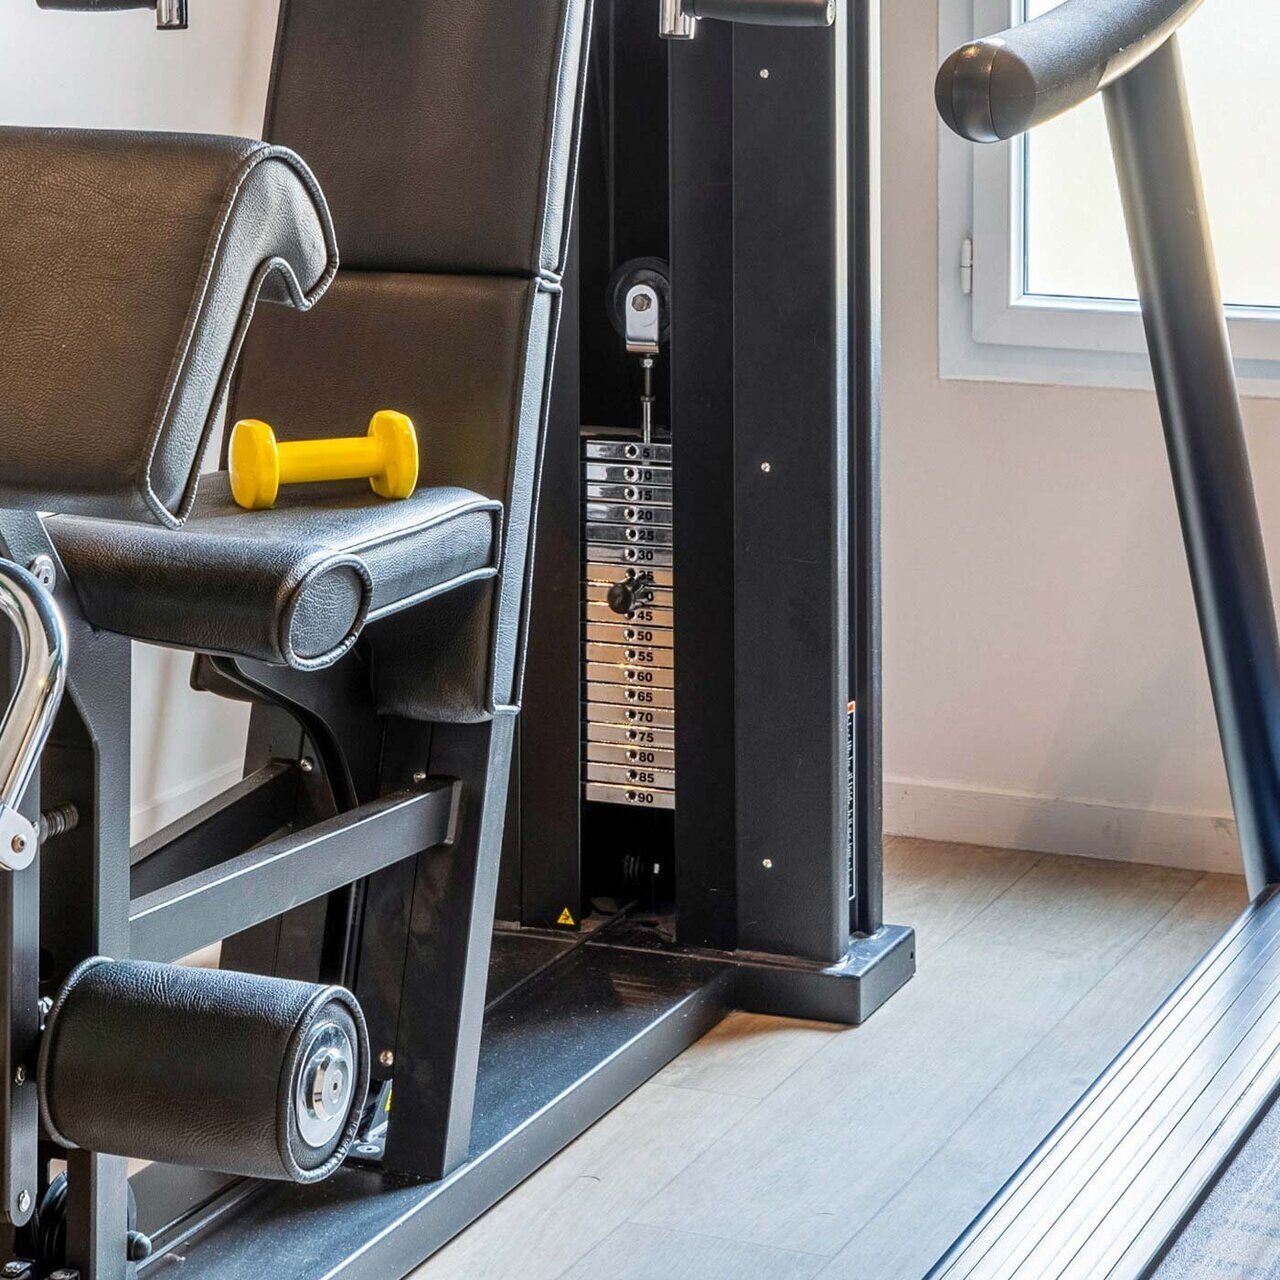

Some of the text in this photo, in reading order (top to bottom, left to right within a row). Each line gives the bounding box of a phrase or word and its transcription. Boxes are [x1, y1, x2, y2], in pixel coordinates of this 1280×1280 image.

[642, 447, 650, 458] 5
[638, 470, 652, 481] 10
[638, 490, 652, 501] 15
[638, 510, 653, 521] 20
[638, 530, 654, 541] 25
[638, 550, 653, 561] 30
[637, 610, 653, 621] 45
[637, 631, 652, 641] 50
[638, 651, 653, 662] 55
[637, 671, 653, 682] 60
[637, 691, 653, 702] 65
[638, 712, 653, 722] 70
[639, 731, 654, 742] 75
[638, 752, 654, 763] 80
[639, 772, 654, 783] 85
[638, 792, 654, 804] 90
